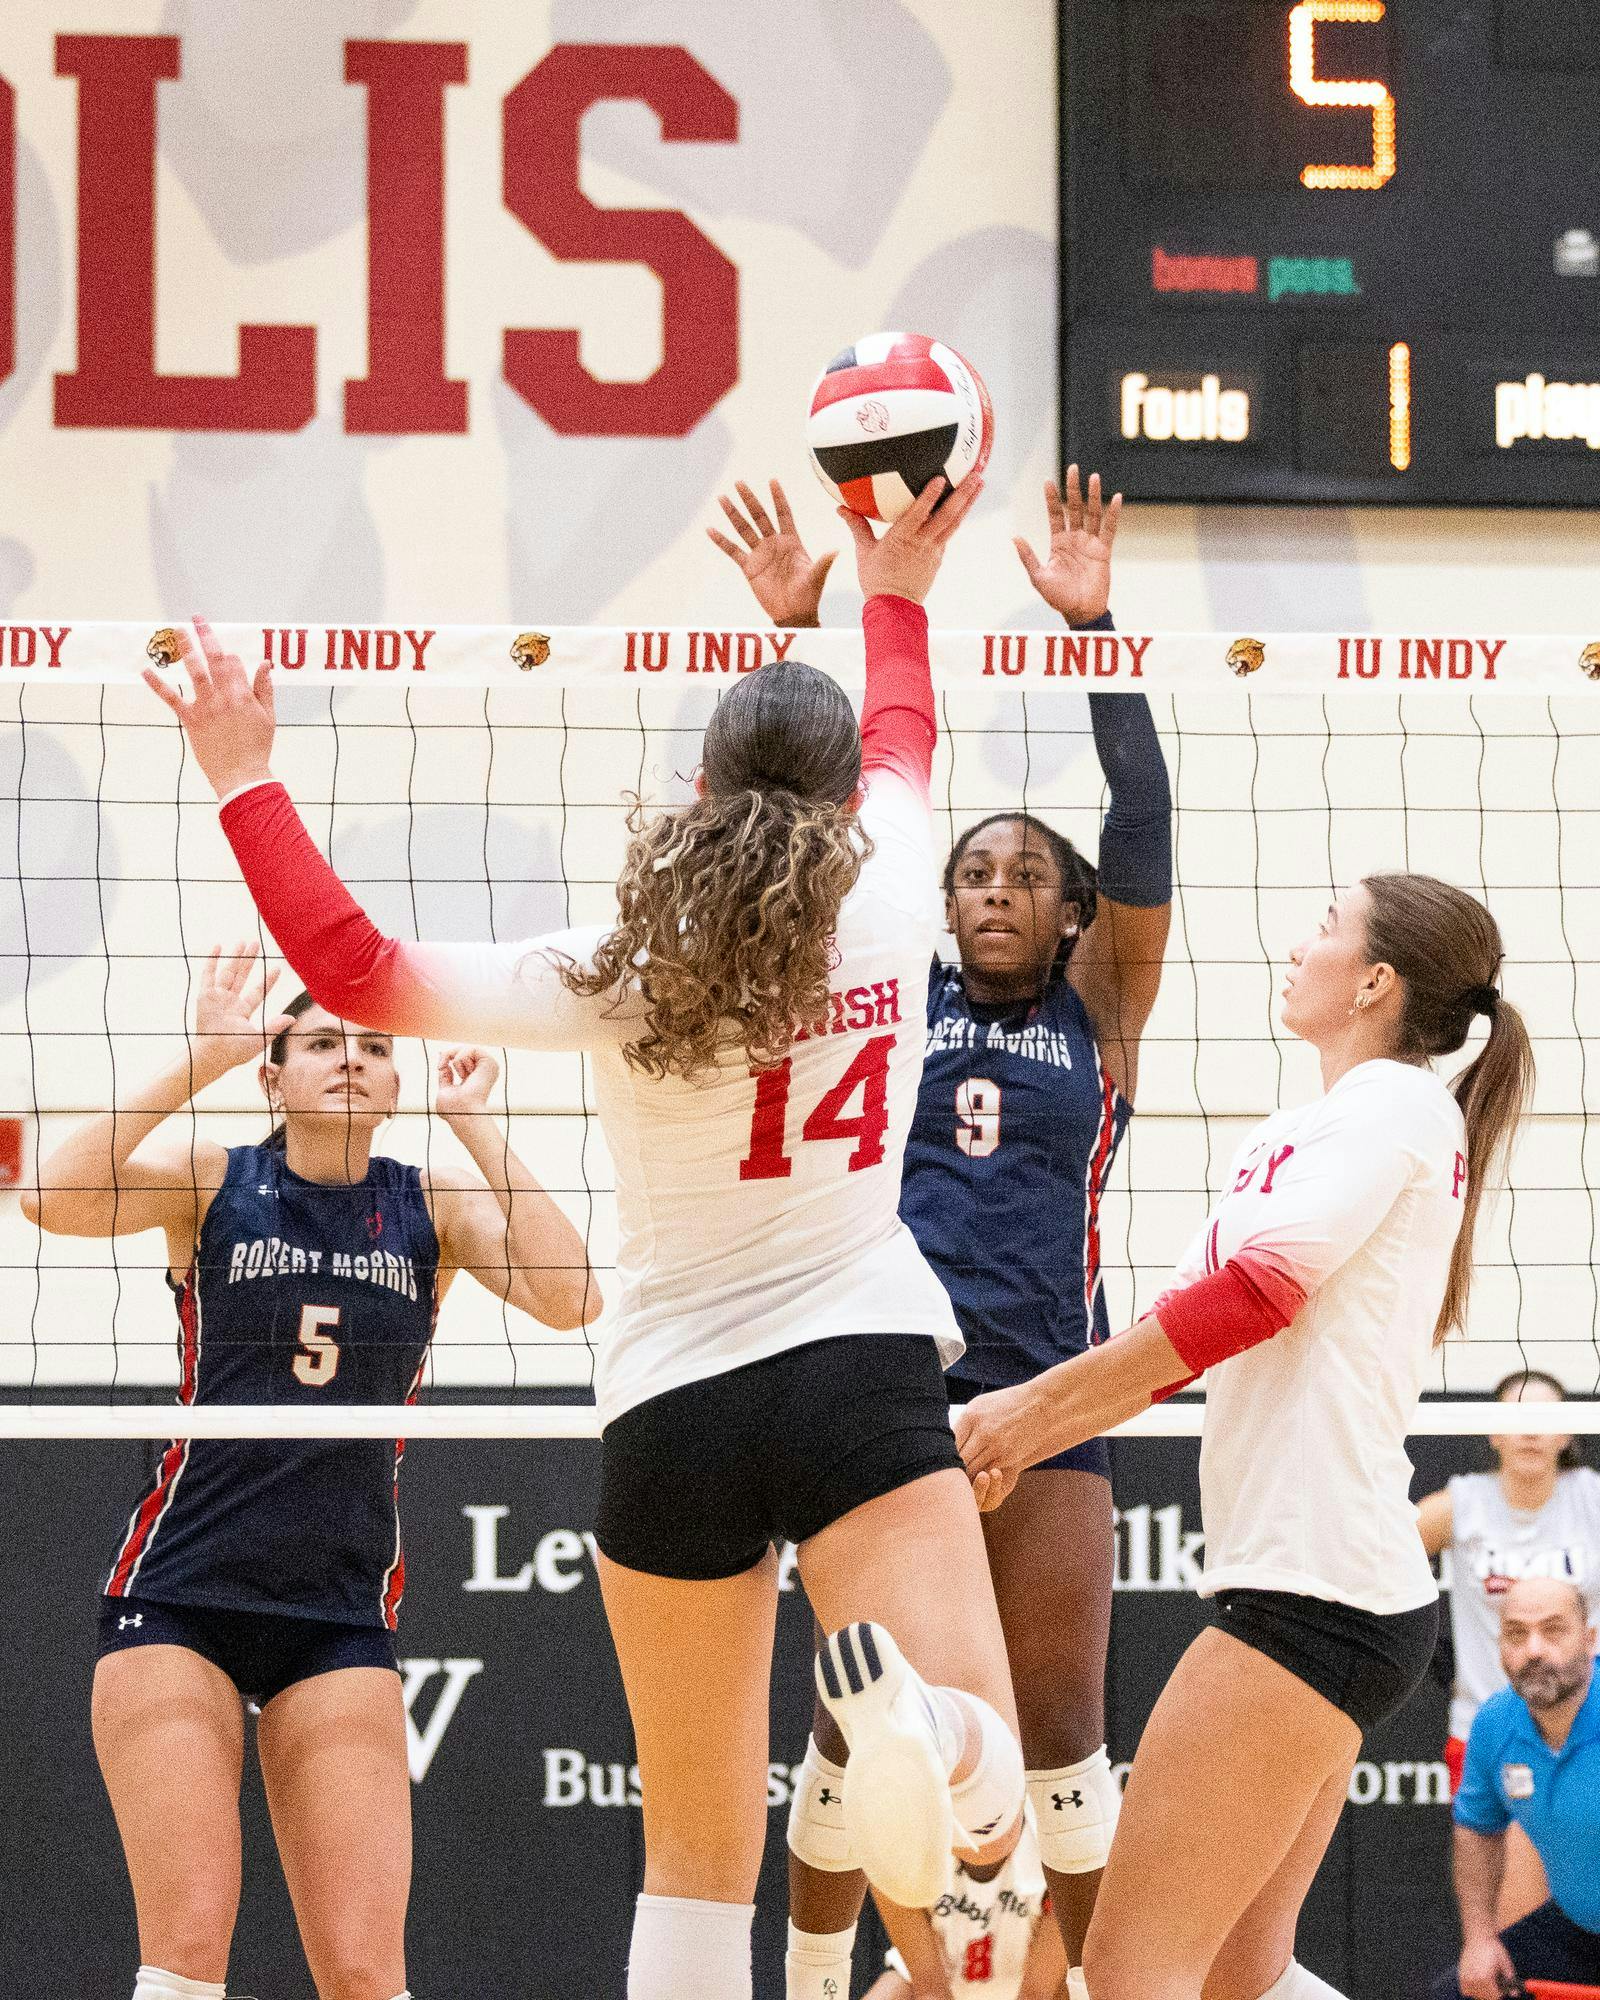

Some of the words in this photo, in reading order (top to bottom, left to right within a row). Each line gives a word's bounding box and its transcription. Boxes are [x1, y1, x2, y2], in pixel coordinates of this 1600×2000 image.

[1289, 0, 1396, 189] 5
[0, 34, 741, 438] LIS
[1120, 372, 1250, 441] fouls
[1389, 341, 1411, 470] 1
[262, 628, 309, 670] IU
[324, 629, 437, 671] INDY
[623, 632, 669, 672] IU
[686, 632, 797, 673] INDY
[982, 635, 1028, 676] IU
[1043, 636, 1154, 677] INDY
[1337, 638, 1383, 679] IU
[1398, 639, 1508, 680] INDY
[739, 1033, 898, 1181] 14
[954, 1077, 1001, 1158] 9
[229, 1237, 322, 1285] ROBERT
[332, 1250, 418, 1302] MORRIS
[291, 1304, 341, 1388] 5
